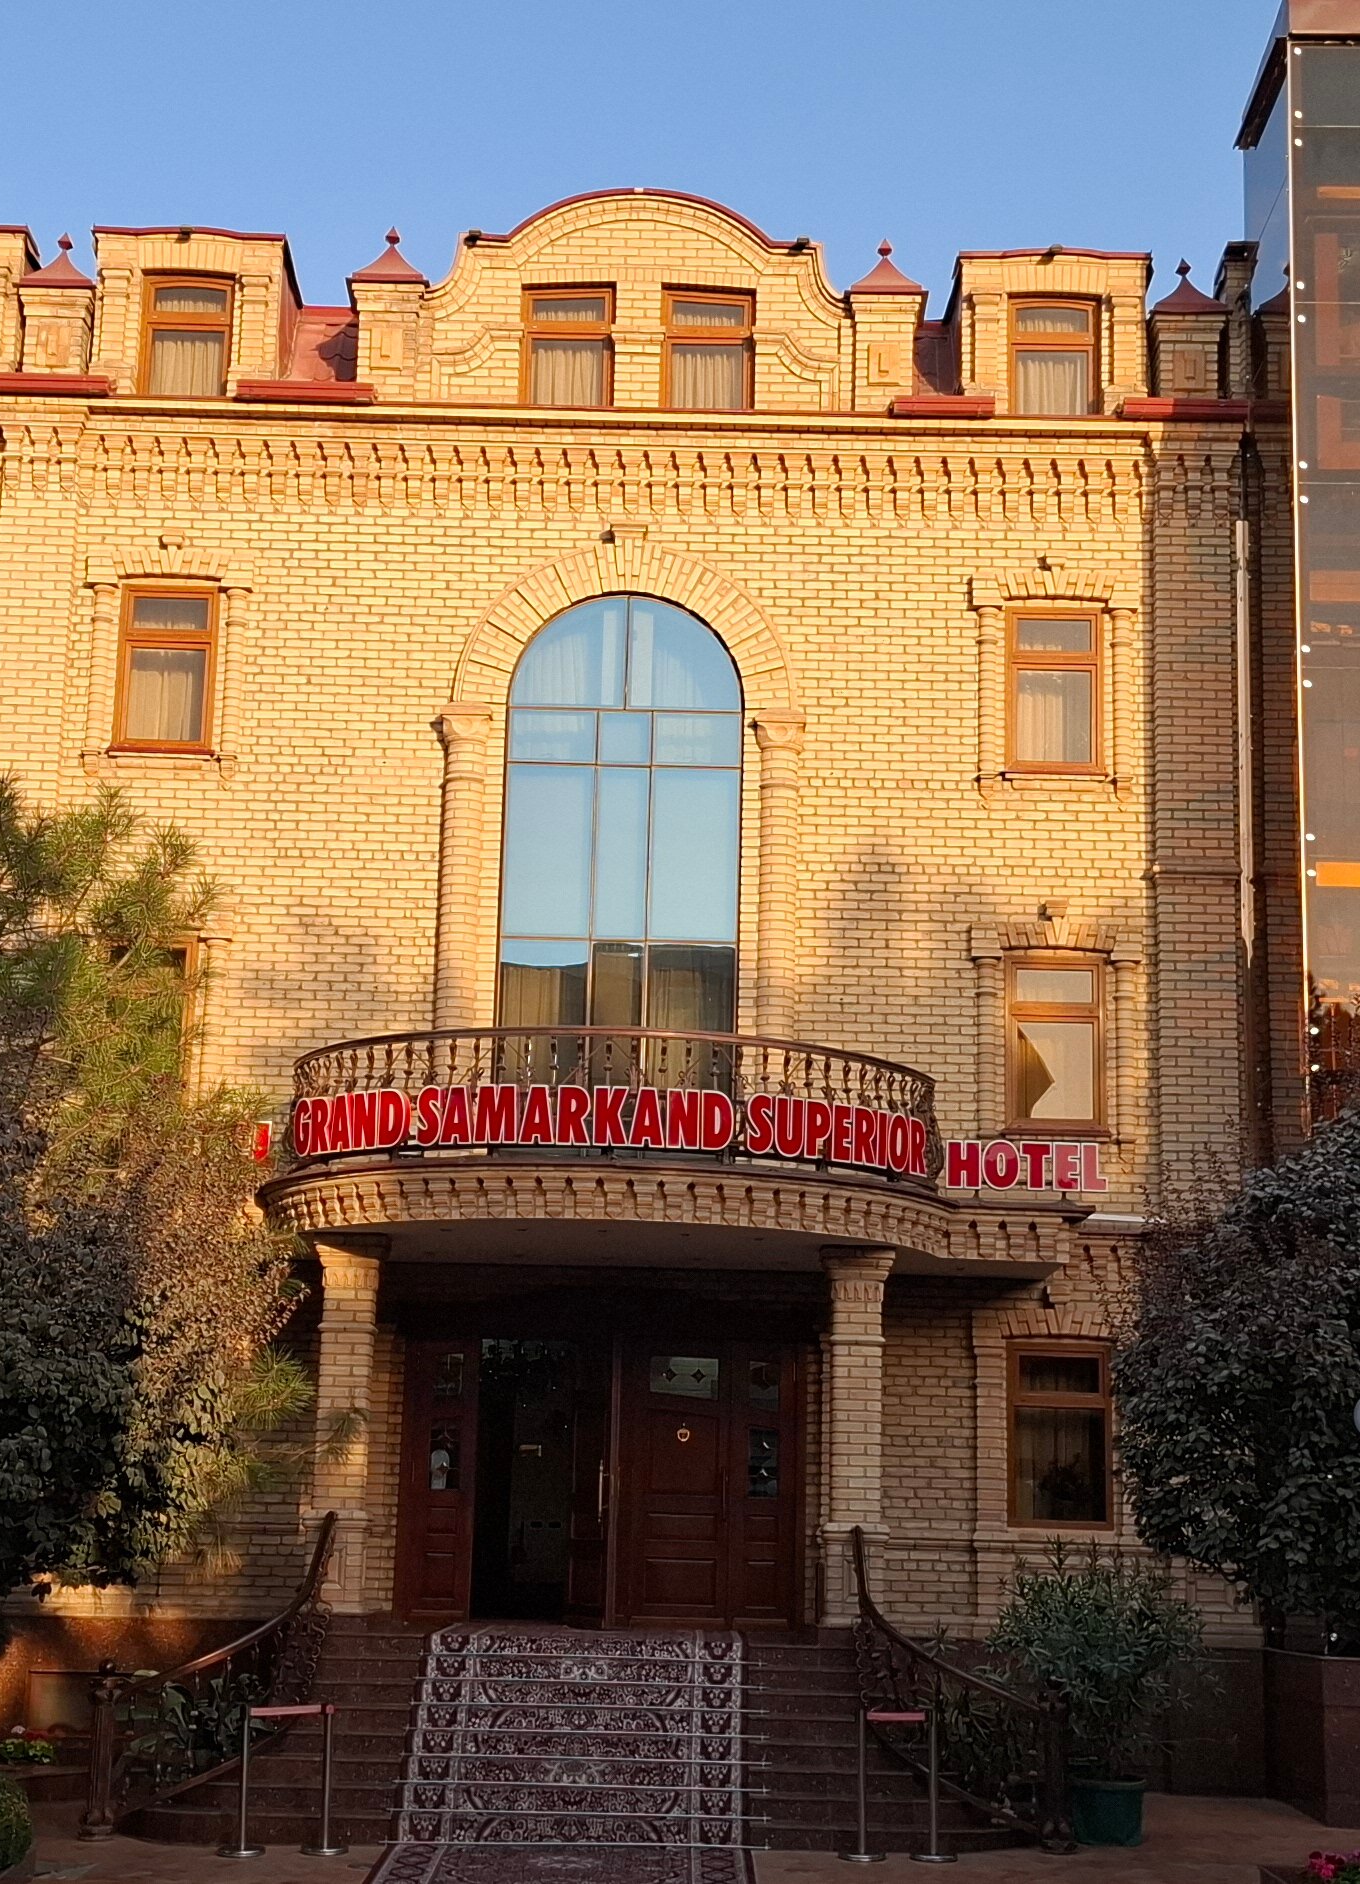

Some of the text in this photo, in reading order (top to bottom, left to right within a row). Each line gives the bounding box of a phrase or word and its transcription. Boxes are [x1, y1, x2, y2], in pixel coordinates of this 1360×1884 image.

[294, 1089, 411, 1157] GRAND
[416, 1084, 734, 1150] SAMARKAND
[747, 1093, 928, 1177] SUPERIOR
[946, 1139, 1108, 1192] HOTEL
